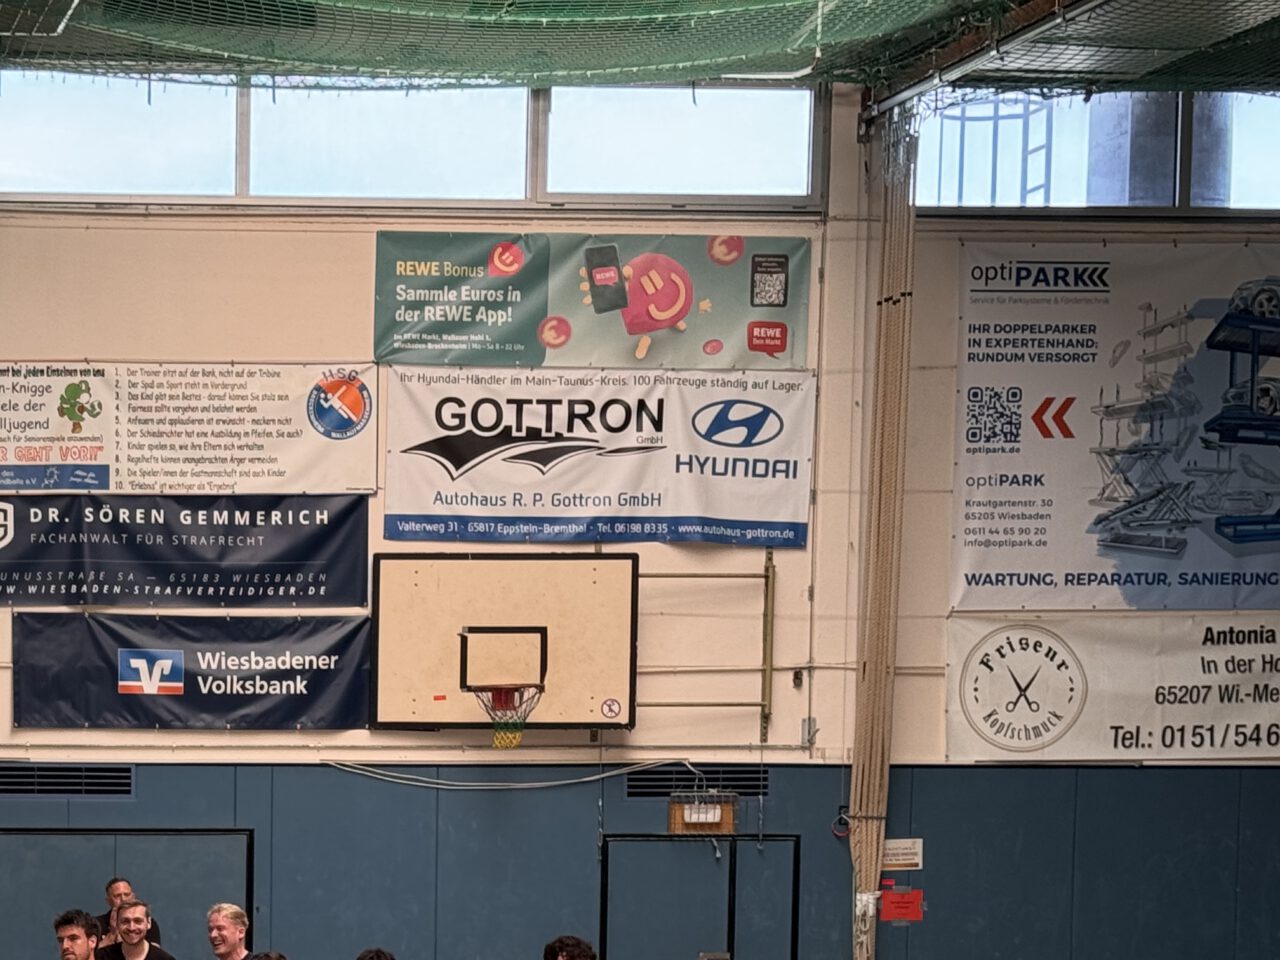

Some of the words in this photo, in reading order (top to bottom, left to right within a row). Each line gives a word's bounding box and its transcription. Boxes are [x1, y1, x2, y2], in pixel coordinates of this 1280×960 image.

[396, 260, 440, 276] REWE
[444, 262, 484, 278] Bonus
[596, 270, 616, 280] REWE
[970, 261, 1090, 287] optiPARK
[396, 284, 458, 301] Sammle
[460, 286, 504, 302] Euros
[507, 286, 522, 302] in
[395, 306, 424, 322] der
[424, 306, 472, 322] REWE
[475, 307, 513, 326] App!
[753, 328, 782, 338] REWE
[968, 324, 991, 334] IHR
[994, 324, 1097, 334] DOPPELPARKER
[968, 338, 982, 348] IN
[968, 352, 1026, 362] RUNDUM
[1028, 352, 1098, 362] VERSORGT
[322, 368, 359, 382] HSG
[400, 374, 414, 383] Ihr
[417, 374, 507, 388] Hyundai-Händler
[510, 376, 522, 385] im
[526, 375, 628, 387] Main-Taunus-Kreis.
[632, 375, 651, 386] 100
[654, 376, 708, 388] Fahrzeuge
[710, 378, 748, 391] ständig
[751, 380, 768, 390] auf
[772, 380, 804, 394] Lager.
[23, 400, 46, 412] der
[434, 396, 665, 432] GOTTRON
[636, 436, 664, 444] GmbH
[14, 446, 53, 462] GEHT
[966, 446, 1021, 454] optipark.de
[675, 454, 798, 480] HYUNDAI
[966, 473, 1045, 490] optiPARK
[433, 491, 507, 507] Autohaus
[512, 492, 527, 507] R.
[532, 493, 545, 508] P.
[551, 493, 612, 508] Gottron
[618, 492, 662, 507] GmbH
[965, 500, 1038, 509] Krautgartenstr.
[1040, 500, 1054, 508] 30
[30, 508, 70, 523] DR.
[84, 504, 165, 524] SÖREN
[179, 509, 329, 526] GEMMERICH
[964, 512, 995, 520] 65205
[998, 512, 1052, 520] Wiesbaden
[397, 521, 445, 532] Valterweg
[447, 522, 458, 531] 31
[468, 522, 495, 532] 65817
[498, 523, 586, 534] Eppstein-Bremthal
[597, 523, 613, 533] Tel.
[614, 523, 642, 533] 06198
[644, 523, 668, 533] 8335
[678, 524, 794, 539] www.autohaus-gottron.de
[964, 528, 986, 536] 0611
[988, 528, 1000, 536] 44
[1003, 528, 1015, 536] 65
[1034, 528, 1046, 536] 20
[30, 533, 128, 544] FACHANWALT
[136, 532, 164, 545] FÜR
[172, 535, 265, 546] STRAFRECHT
[964, 538, 1048, 549] info@optipark.de
[169, 573, 220, 583] 65183
[232, 573, 327, 584] WIESBADEN
[964, 572, 1058, 588] WARTUNG,
[1064, 572, 1172, 587] REPARATUR,
[1177, 572, 1280, 586] SANIERUNG
[1202, 624, 1277, 646] Antonia
[197, 650, 340, 671] Wiesbadener
[1200, 656, 1218, 674] In
[1224, 655, 1256, 674] der
[197, 675, 308, 695] Volksbank
[1154, 685, 1212, 705] 65207
[1110, 726, 1154, 749] Tel.:
